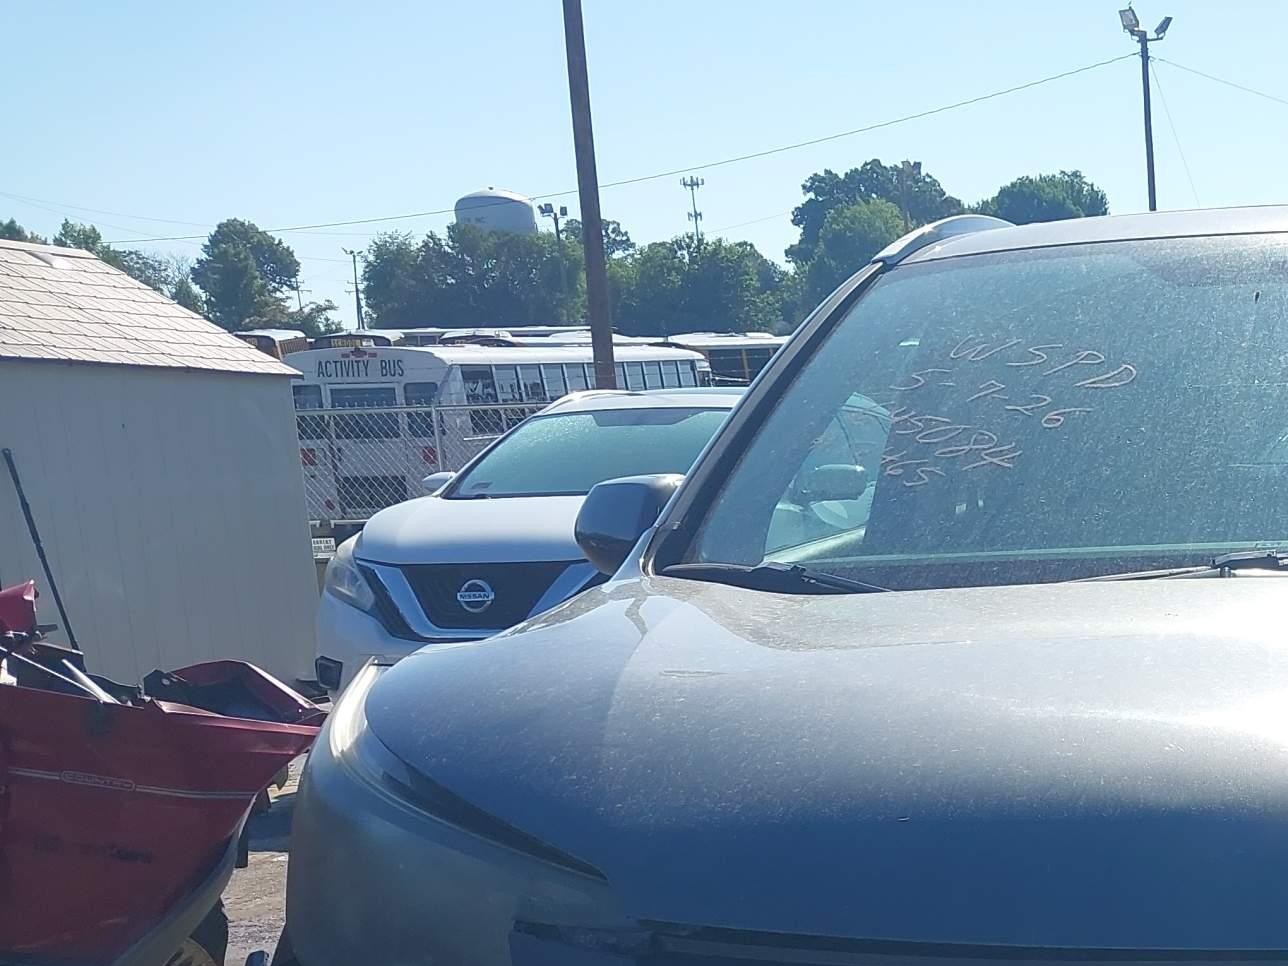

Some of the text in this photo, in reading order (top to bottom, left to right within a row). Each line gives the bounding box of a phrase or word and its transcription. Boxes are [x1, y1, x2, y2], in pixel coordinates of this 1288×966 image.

[317, 360, 404, 378] ACTIVITY BUS
[459, 592, 490, 600] NISSAN
